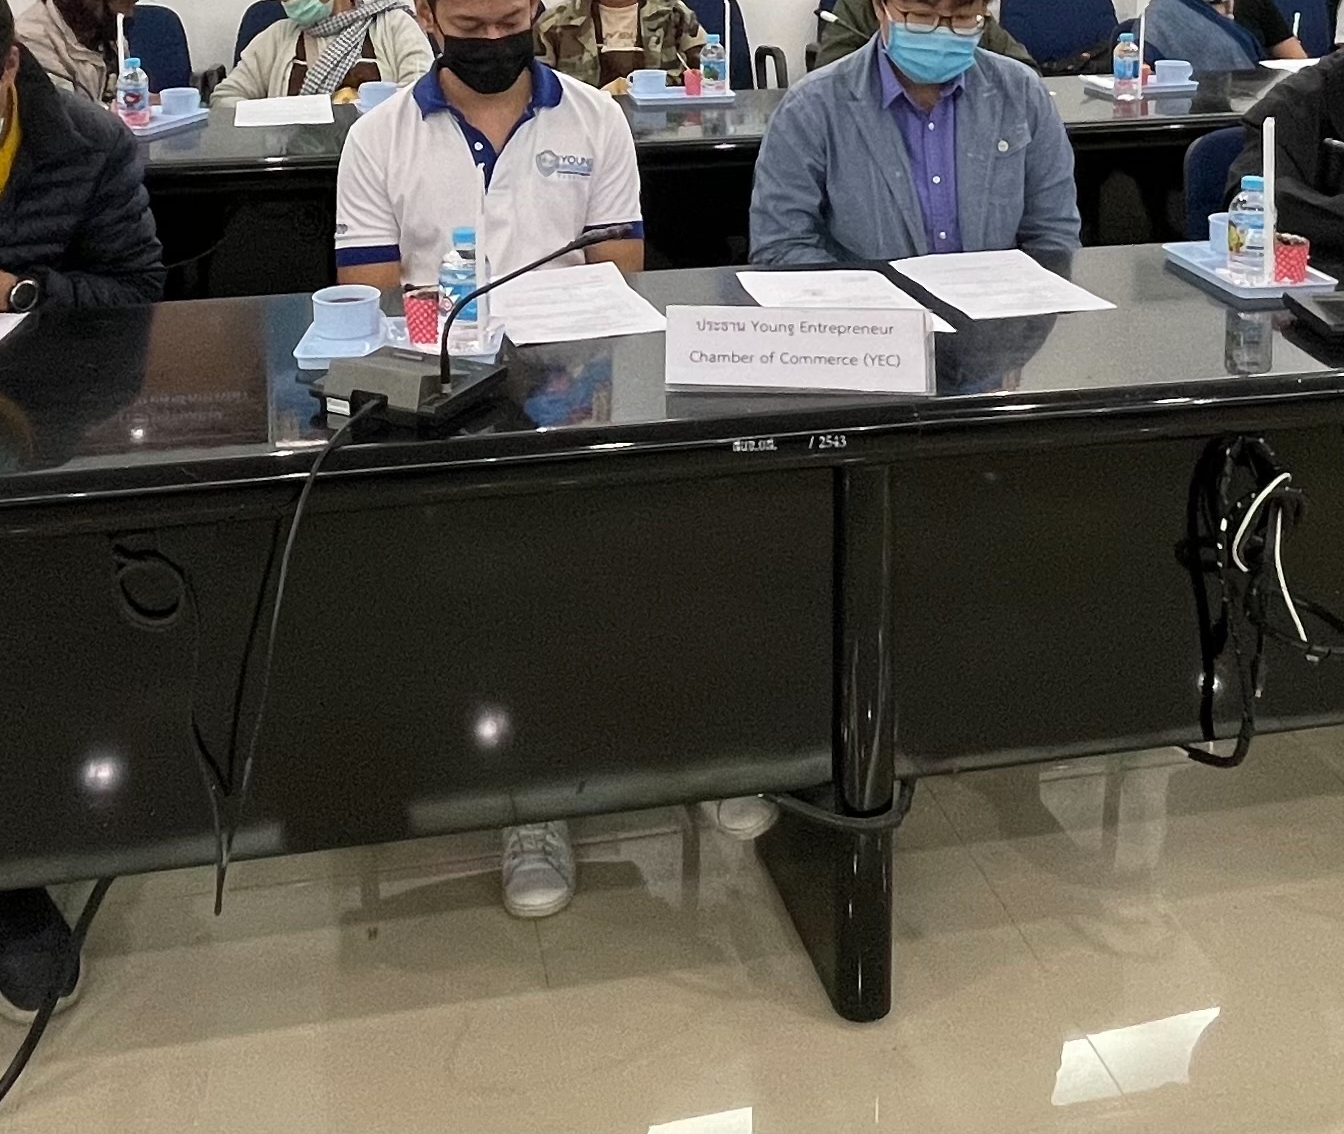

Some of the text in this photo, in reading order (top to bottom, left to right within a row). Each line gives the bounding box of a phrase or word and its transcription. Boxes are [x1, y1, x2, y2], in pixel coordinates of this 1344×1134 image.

[696, 317, 894, 337] ประธาน Young Entrepreneur
[689, 349, 901, 368] Chamber of Commerce (YEC)
[818, 434, 847, 449] 2543
